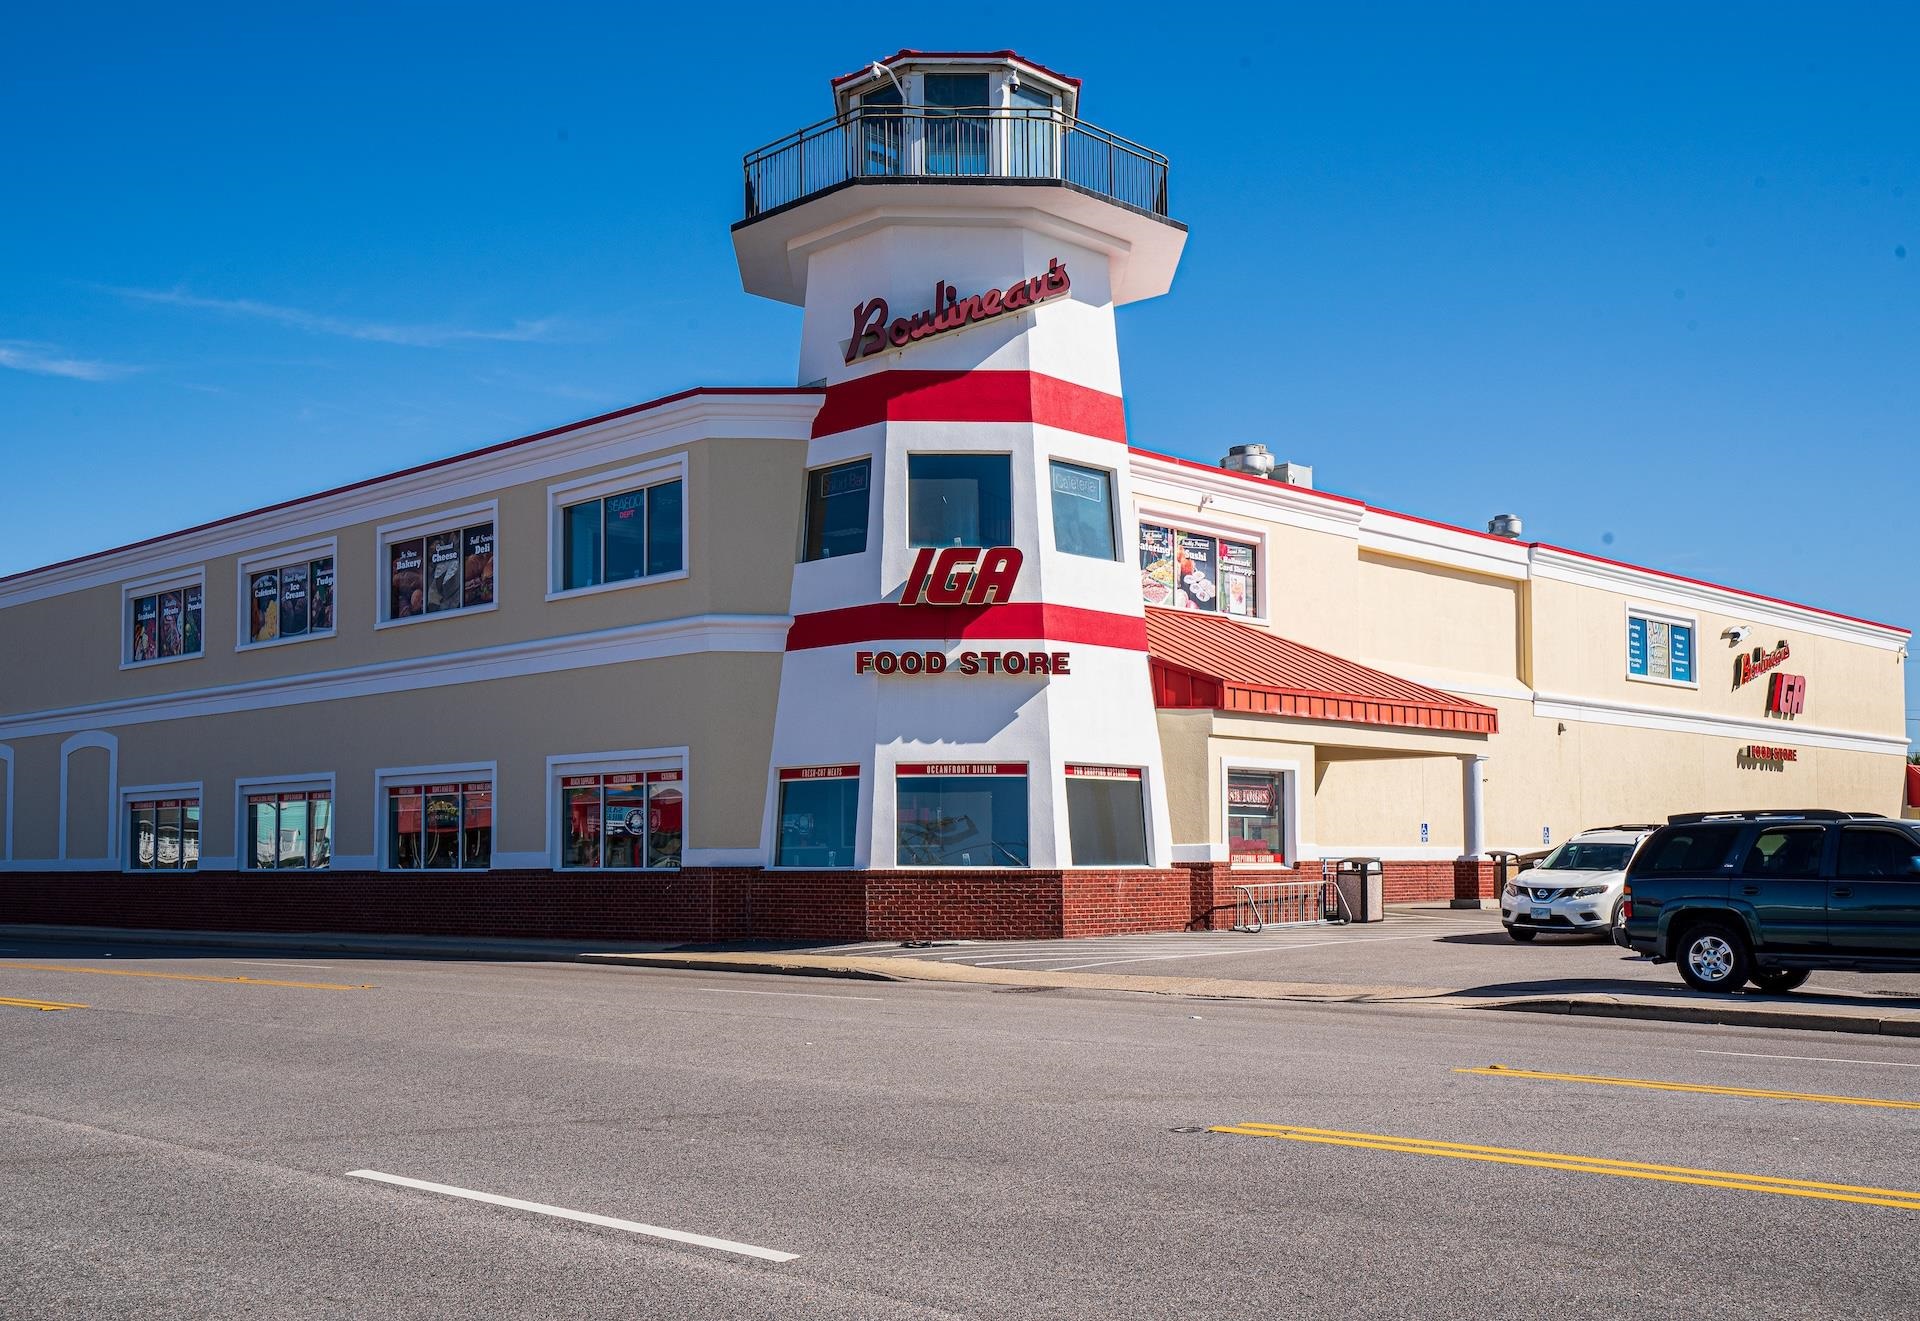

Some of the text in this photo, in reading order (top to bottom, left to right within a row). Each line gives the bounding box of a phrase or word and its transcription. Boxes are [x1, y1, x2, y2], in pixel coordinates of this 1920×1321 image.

[845, 258, 1071, 363] Boulineau's
[619, 509, 635, 519] DEPT
[475, 543, 490, 554] Deli
[1140, 542, 1171, 556] atering
[432, 552, 457, 563] Cheese
[1185, 550, 1207, 562] Sushi
[396, 560, 421, 570] Bakery
[899, 546, 1023, 606] IGA
[290, 583, 299, 591] Ice
[285, 592, 305, 600] Cream
[855, 651, 1071, 676] FOOD STORE
[1771, 673, 1806, 714] IGA
[1752, 745, 1797, 761] FOOD STORE
[827, 768, 842, 776] MEATS
[926, 765, 997, 774] OCEANFRONT DINING
